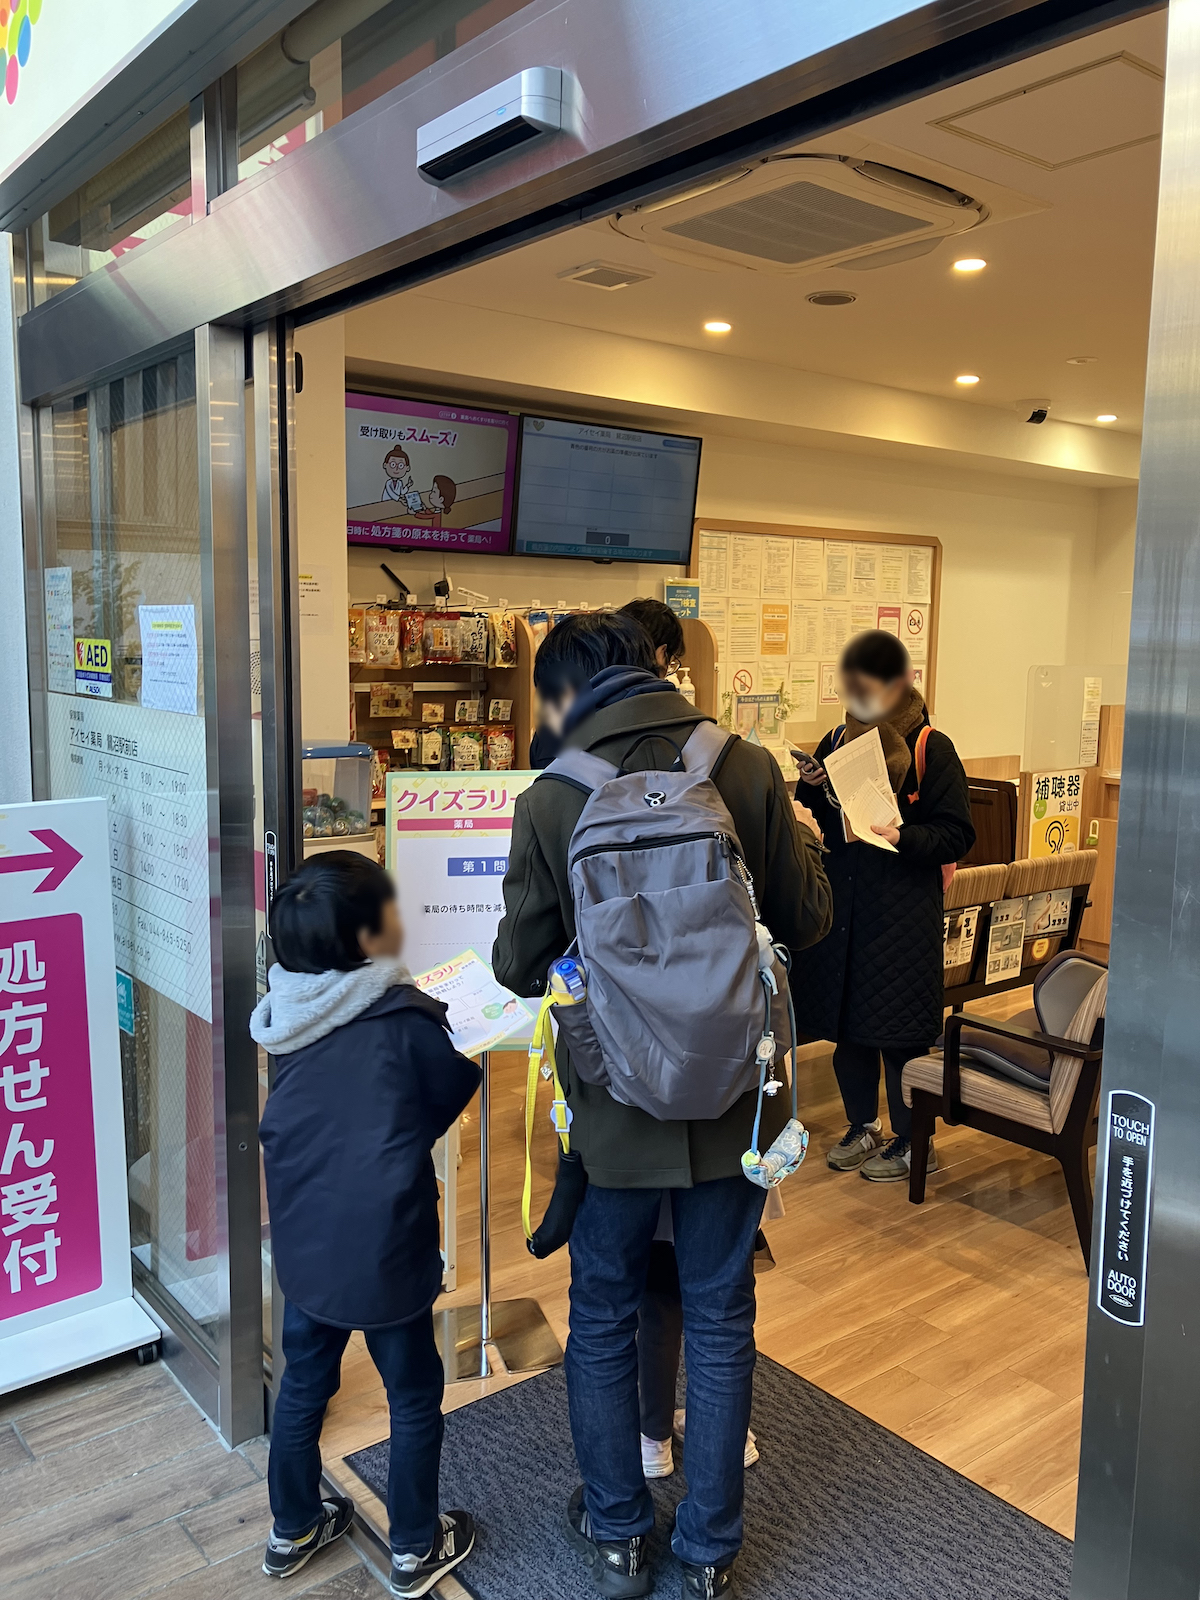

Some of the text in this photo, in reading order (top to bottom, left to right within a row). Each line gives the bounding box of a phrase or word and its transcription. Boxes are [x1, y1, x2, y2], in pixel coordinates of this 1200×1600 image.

[604, 535, 611, 545] 0
[86, 644, 108, 668] AED
[1035, 774, 1080, 801] 補聴器
[396, 788, 517, 813] クイズラリ
[1058, 799, 1080, 813] 貸出中
[453, 818, 474, 830] 薬局
[173, 842, 189, 861] 18:00
[113, 849, 119, 861] 日
[173, 873, 190, 892] 17:00
[415, 961, 463, 988] イズラリー
[0, 938, 62, 1295] 処方せん受付
[1111, 1113, 1150, 1136] TOUCH
[1113, 1125, 1147, 1147] TO OPEN
[1117, 1155, 1135, 1262] 手を近づけてください
[1107, 1269, 1137, 1289] AUTO
[1107, 1279, 1136, 1300] DOOR
